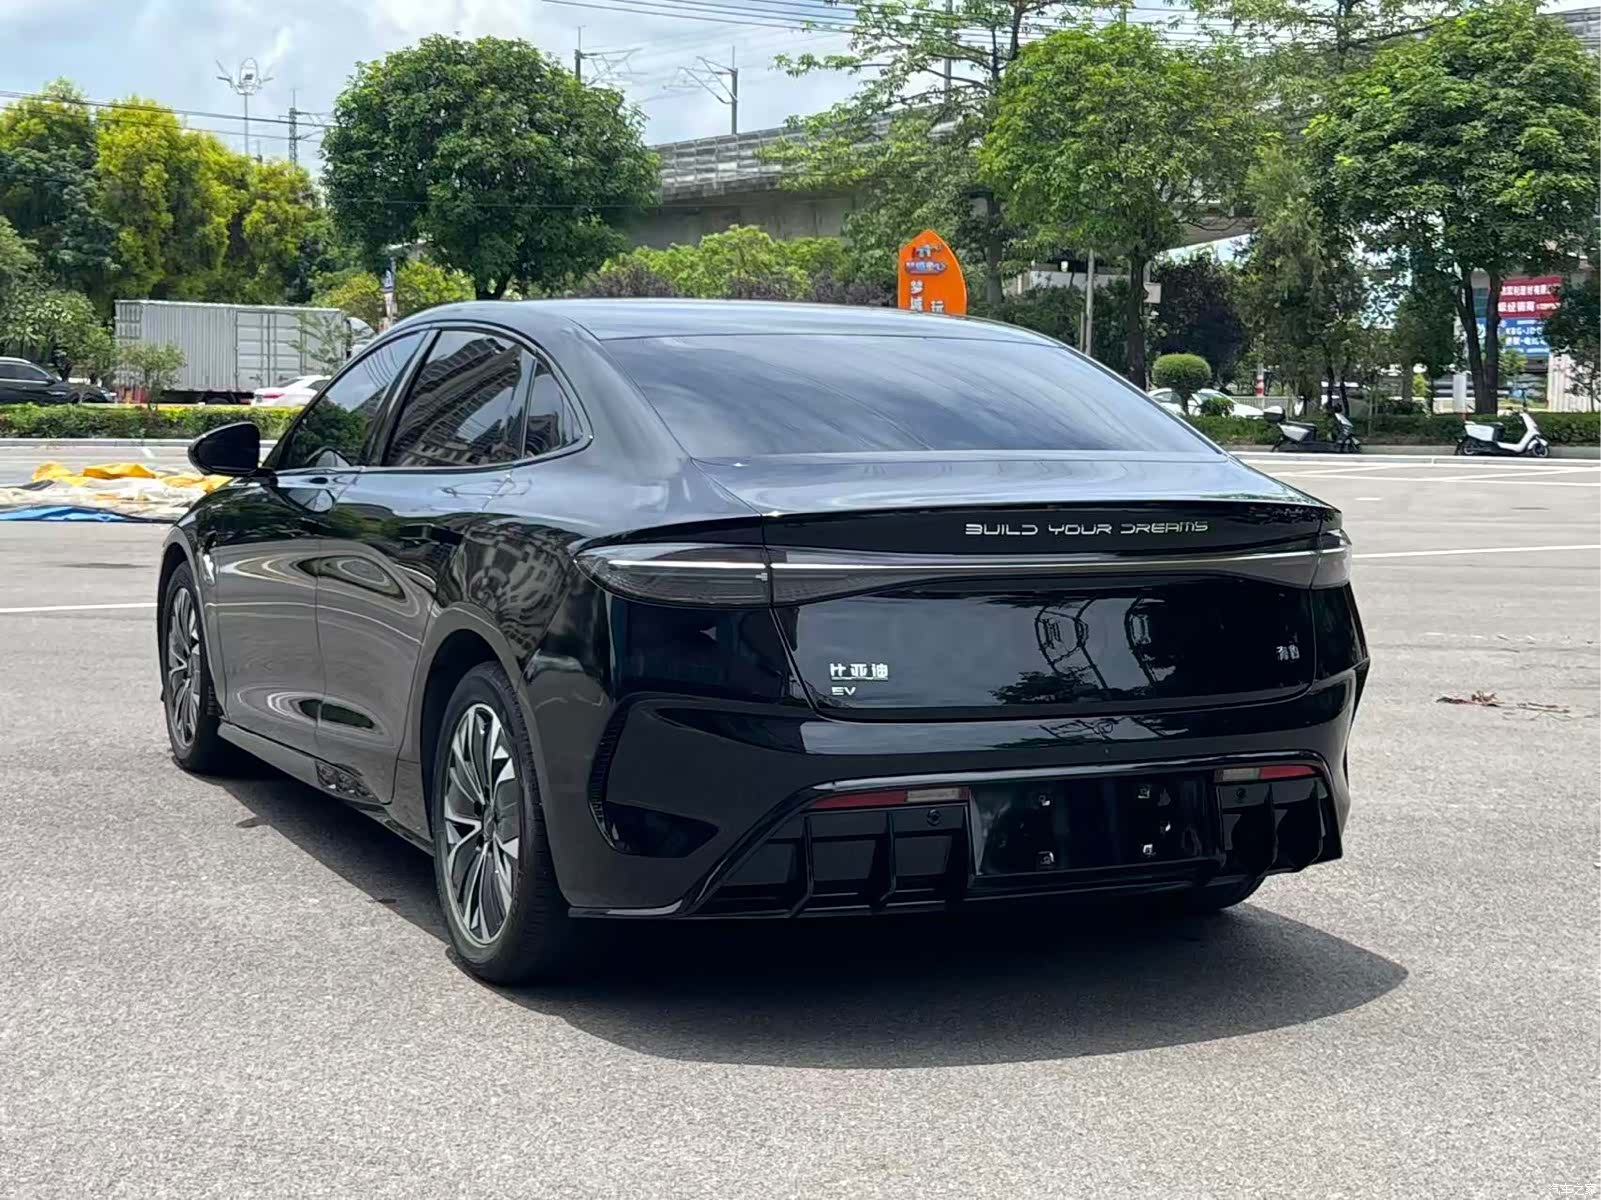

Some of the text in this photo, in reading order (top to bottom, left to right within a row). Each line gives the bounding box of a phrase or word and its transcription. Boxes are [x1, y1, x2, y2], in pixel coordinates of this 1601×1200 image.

[965, 521, 1209, 536] BUILD YOUR DREAMS
[829, 663, 889, 679] 比亚迪
[831, 686, 857, 696] EV
